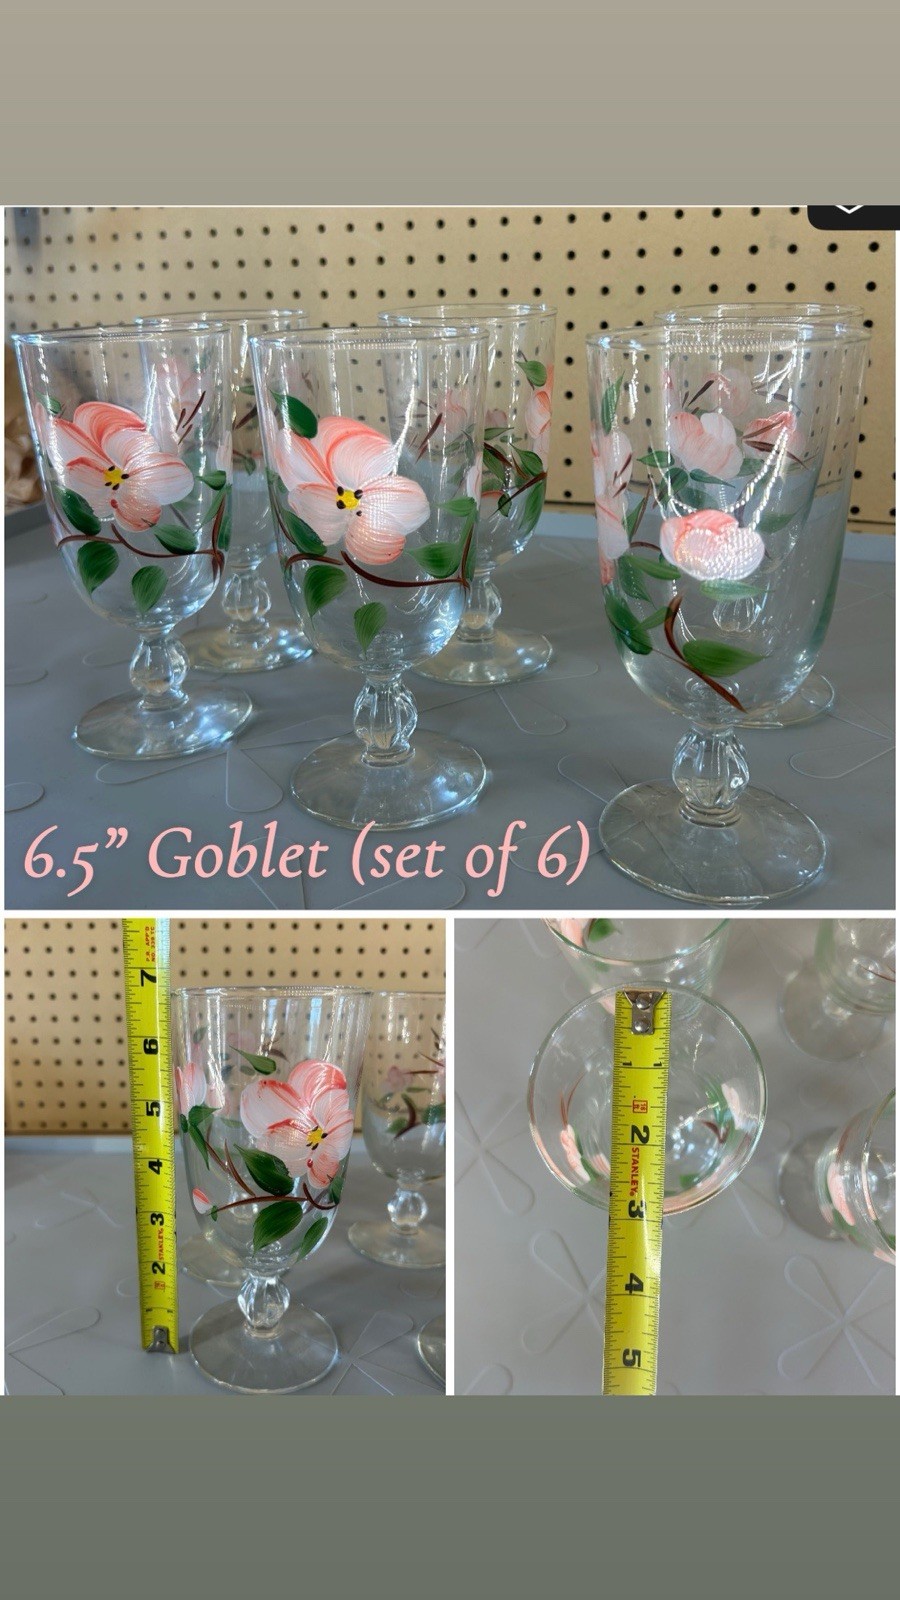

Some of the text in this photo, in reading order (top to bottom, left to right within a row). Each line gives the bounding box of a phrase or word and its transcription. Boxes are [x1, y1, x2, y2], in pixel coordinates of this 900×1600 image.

[140, 969, 157, 987] 7
[143, 1038, 159, 1055] 6
[145, 1101, 160, 1117] 5
[631, 1124, 650, 1145] 2
[148, 1159, 163, 1175] 4
[629, 1146, 639, 1194] STANLEY
[628, 1200, 647, 1219] 3
[150, 1212, 165, 1226] 3
[152, 1261, 166, 1275] 2
[624, 1272, 644, 1294] 4
[622, 1348, 641, 1368] 5
